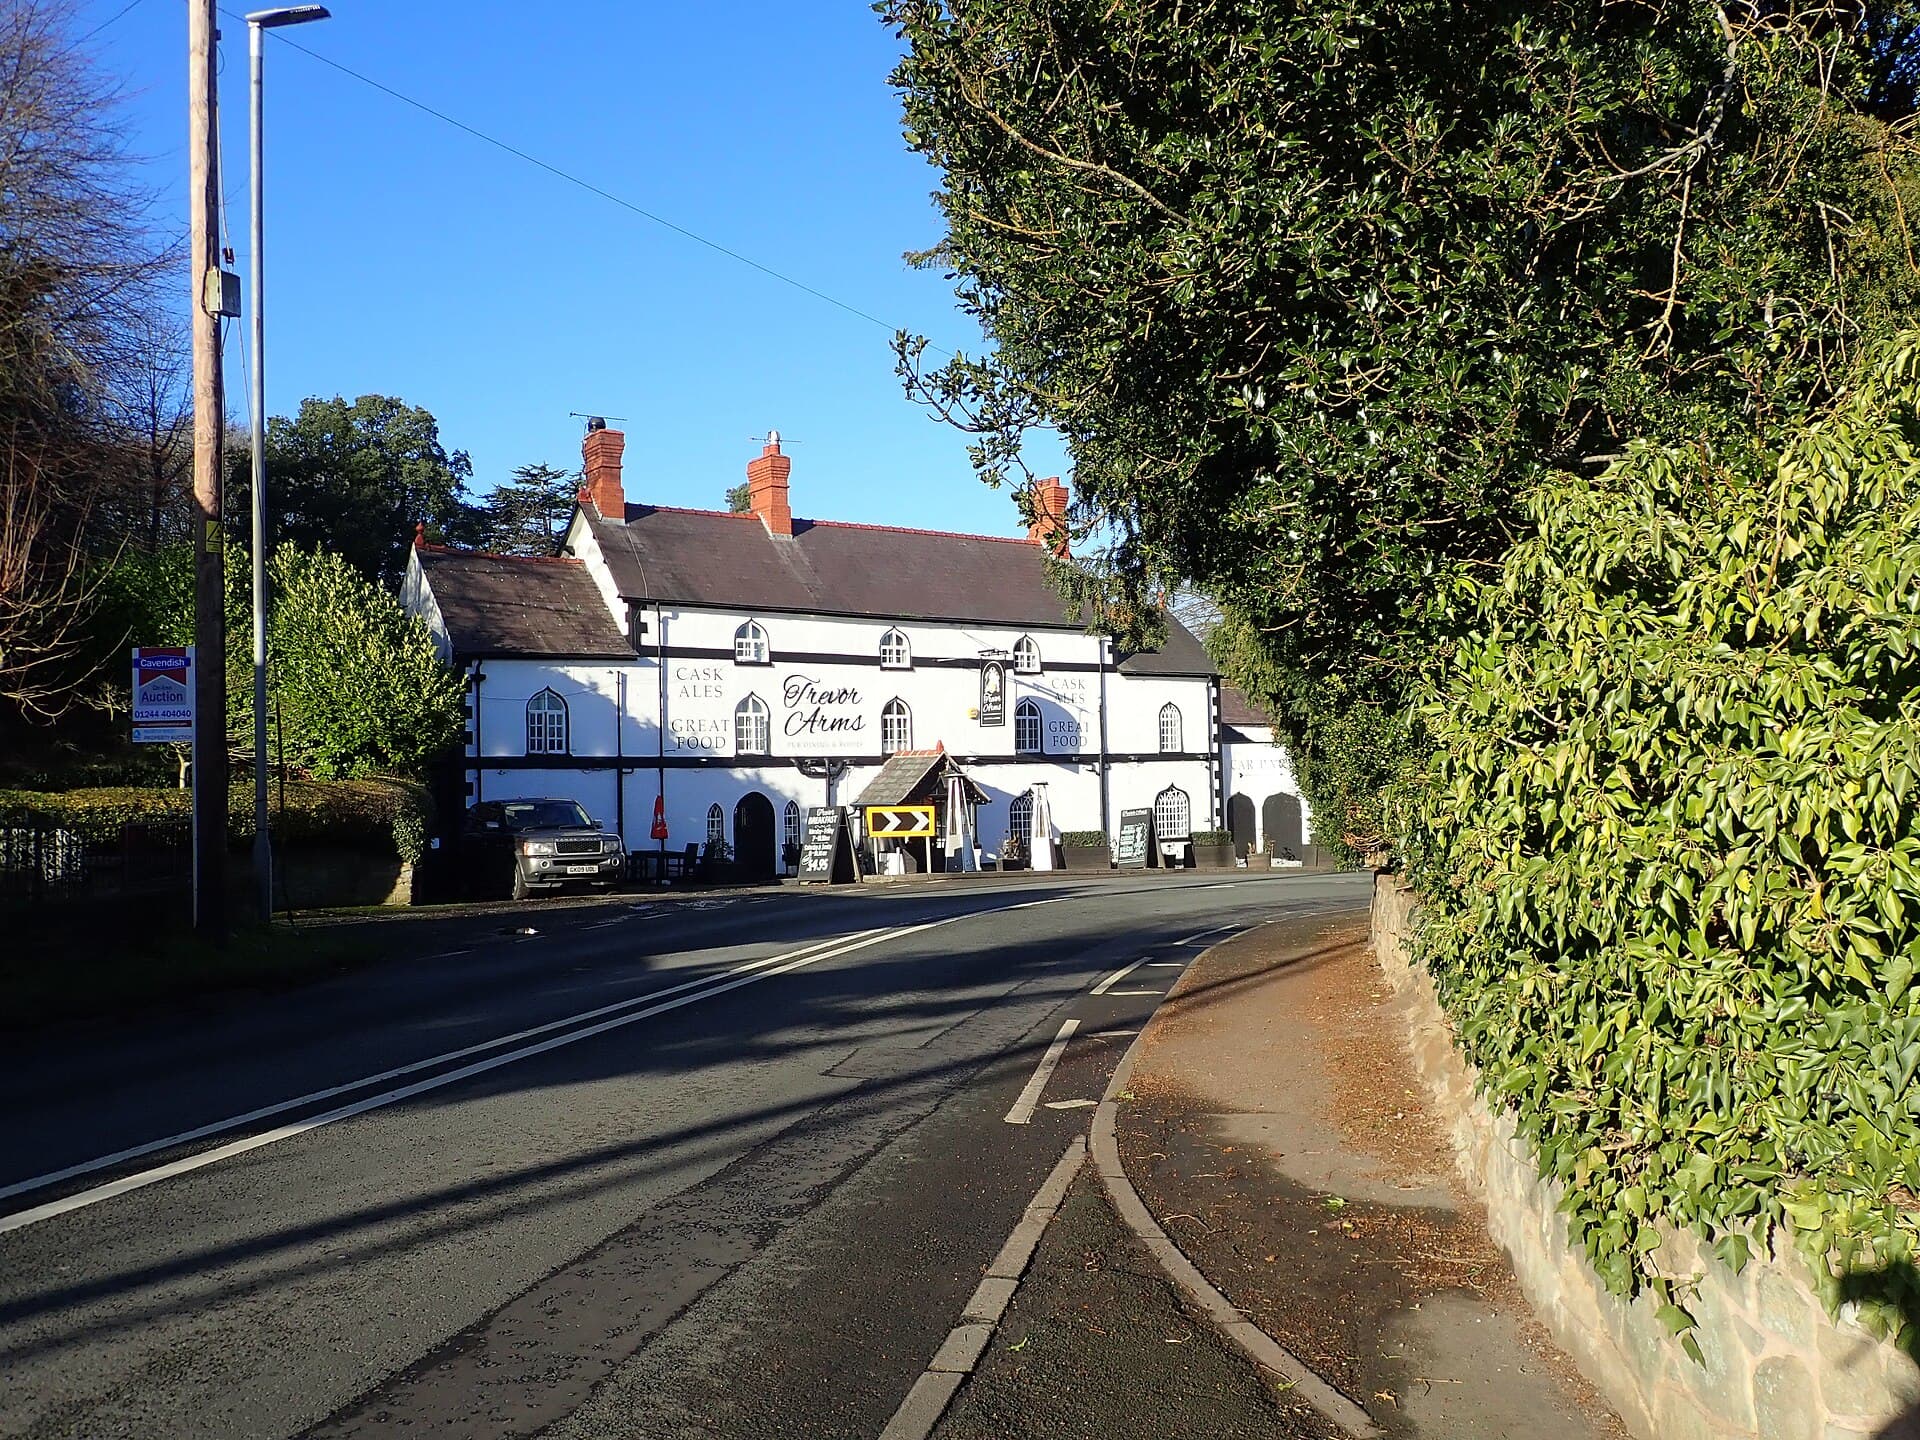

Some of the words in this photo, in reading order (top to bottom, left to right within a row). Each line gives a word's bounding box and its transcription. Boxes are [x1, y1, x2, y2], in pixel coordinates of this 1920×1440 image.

[140, 659, 185, 667] Cavendish
[676, 667, 723, 681] CASK
[1051, 679, 1086, 689] CASK
[142, 690, 183, 702] Auction
[679, 685, 723, 698] ALES
[783, 674, 864, 708] Trevor
[134, 710, 159, 719] 01244
[161, 709, 192, 718] 404040
[671, 718, 730, 732] GREAT
[783, 706, 866, 737] Arms
[1048, 721, 1089, 733] GREAT
[675, 736, 726, 750] FOOD
[1053, 735, 1088, 747] FOOD
